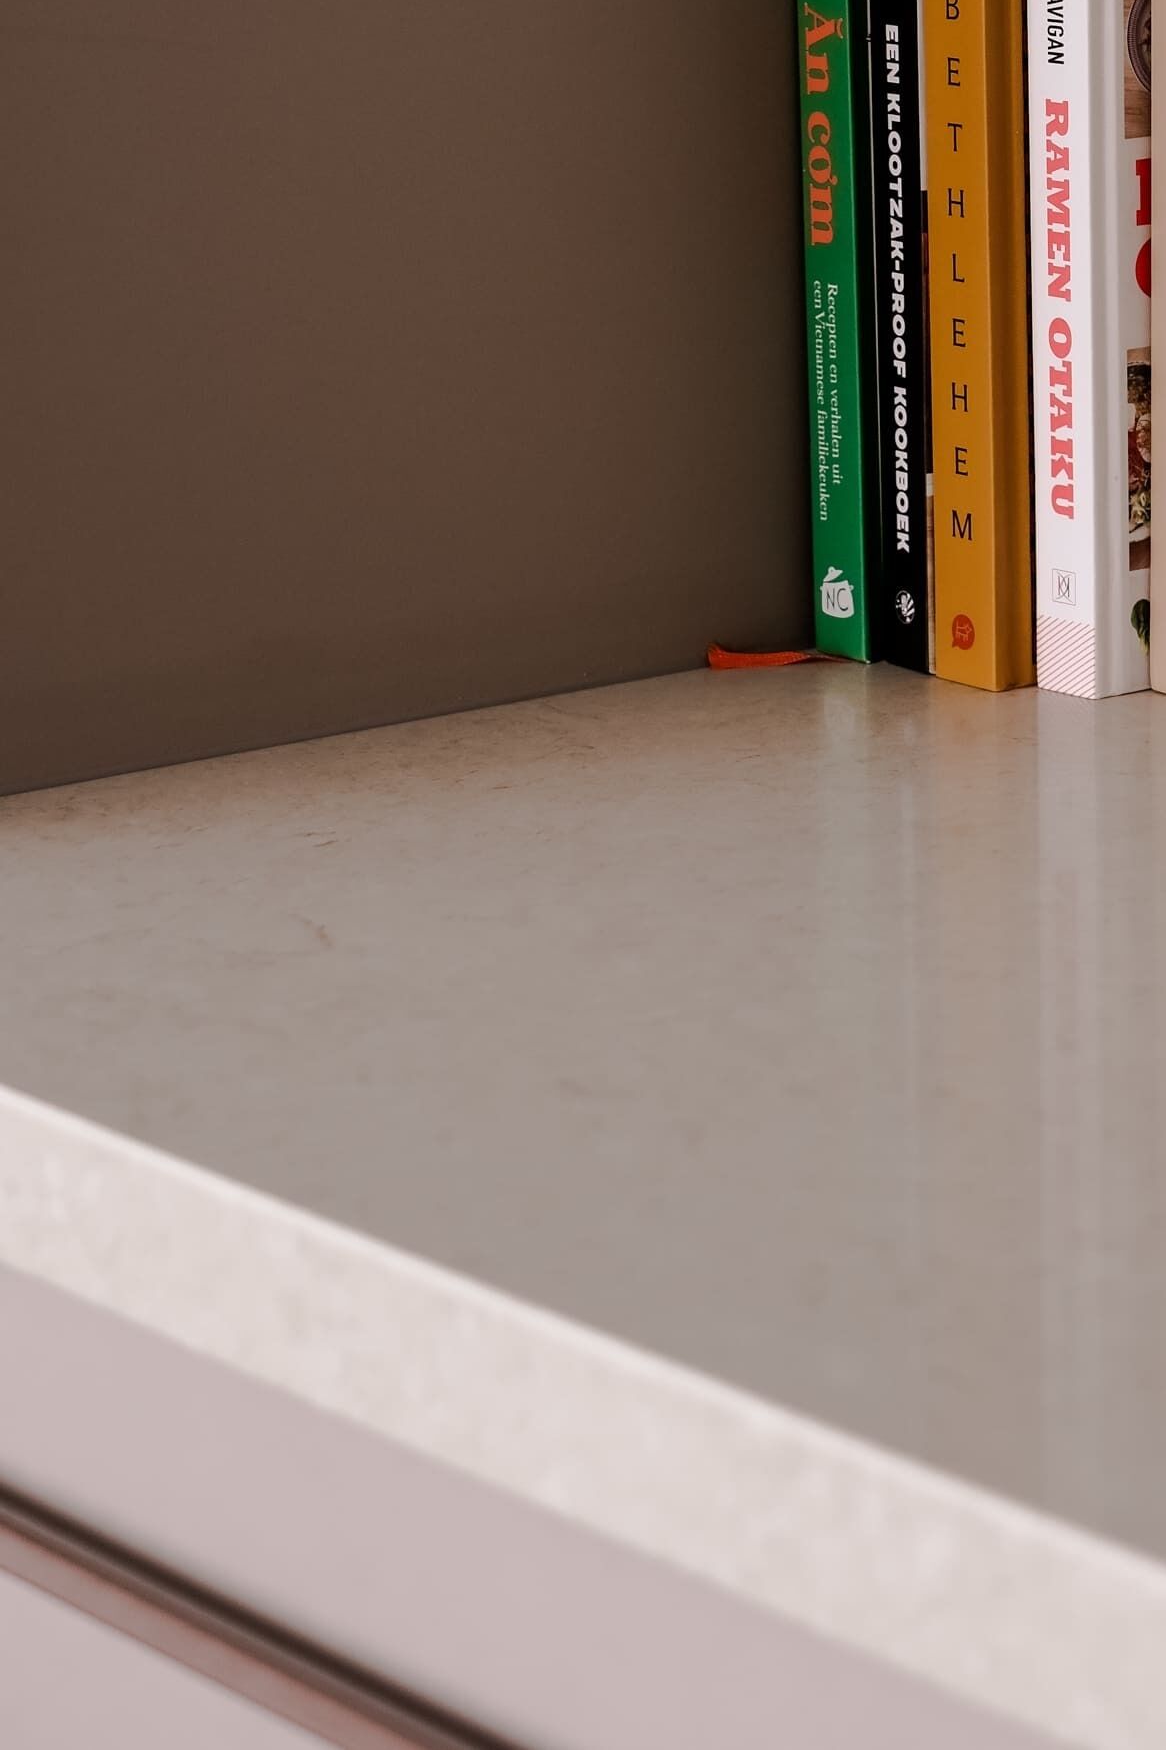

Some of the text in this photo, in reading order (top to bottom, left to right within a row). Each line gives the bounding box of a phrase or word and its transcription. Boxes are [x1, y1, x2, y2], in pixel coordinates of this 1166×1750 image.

[804, 2, 844, 246] Ăn cơm
[885, 24, 900, 84] EEN
[886, 93, 907, 379] KLOOTZAK-PROOF
[1045, 98, 1075, 520] RAMEN OTAKU
[814, 280, 830, 521] een Vietnamese familiekeuken
[825, 283, 843, 485] Recepten en verhalen uit
[893, 385, 910, 553] KOOKBOEK
[826, 587, 849, 612] NC
